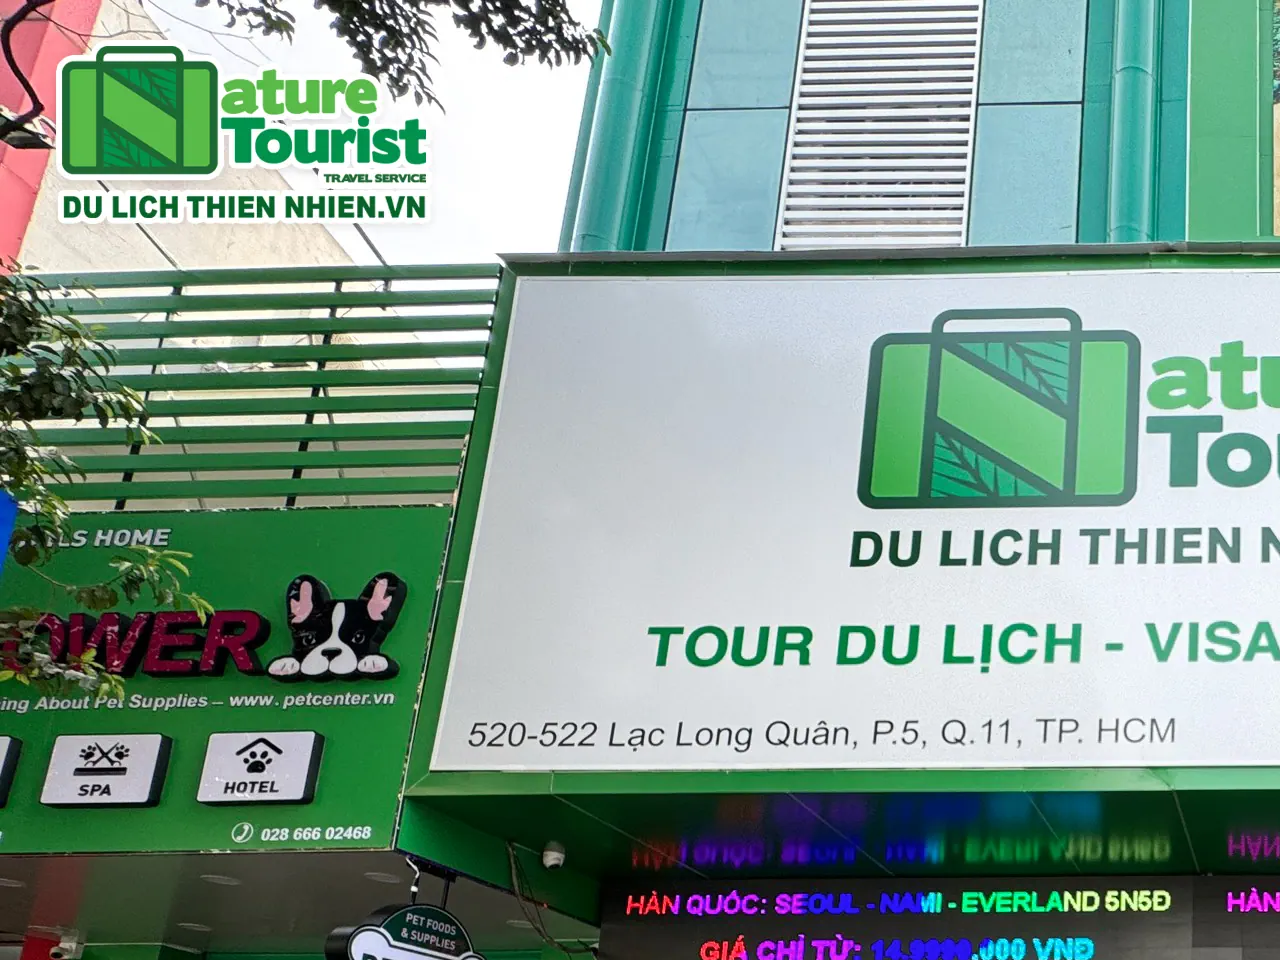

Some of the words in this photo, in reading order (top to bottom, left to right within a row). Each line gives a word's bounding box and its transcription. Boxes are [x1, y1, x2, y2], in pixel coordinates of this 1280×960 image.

[93, 528, 172, 547] HOME
[849, 529, 923, 568] DU
[938, 528, 1061, 567] LICH
[1079, 526, 1242, 566] THIEN
[646, 625, 814, 668] TOUR
[835, 624, 922, 667] DU
[941, 622, 1083, 674] LỊCH
[0, 696, 28, 714] ing
[35, 694, 94, 711] About
[128, 693, 209, 712] Supplies
[466, 720, 598, 749] 520-522
[608, 721, 664, 753] Lạc
[674, 720, 753, 752] Long
[763, 718, 859, 749] Quân,
[872, 719, 928, 748] P.5,
[940, 718, 1025, 748] Q.11,
[1034, 718, 1084, 744] TP.
[1096, 717, 1177, 744] HCM
[77, 784, 112, 798] SPA
[223, 780, 279, 794] HOTEL
[260, 828, 285, 842] 028
[294, 827, 321, 842] 666
[324, 826, 372, 841] 02468
[626, 890, 680, 916] HÀN
[685, 891, 768, 917] QUỐC:
[774, 892, 859, 915] SEOUL
[880, 892, 942, 914] NAMI
[961, 891, 1099, 914] EVERLAND
[1226, 889, 1280, 912] HÀN
[405, 912, 425, 926] PET
[426, 918, 457, 936] FOODS
[401, 927, 409, 938] &
[411, 931, 456, 951] SUPPLIES
